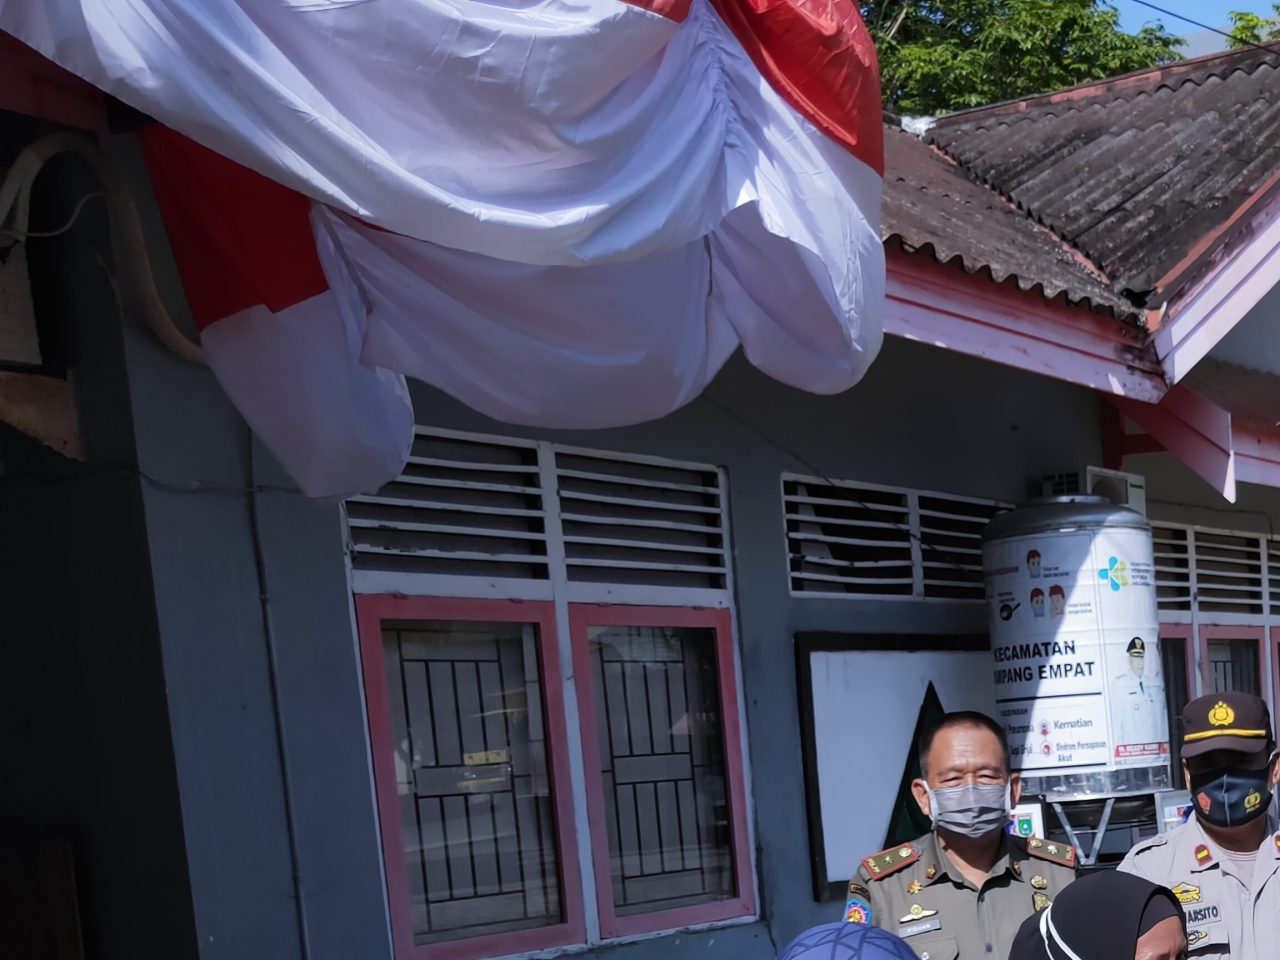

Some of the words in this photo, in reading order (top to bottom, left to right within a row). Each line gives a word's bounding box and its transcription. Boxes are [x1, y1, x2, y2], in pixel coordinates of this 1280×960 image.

[1038, 661, 1095, 679] EMPAT
[1053, 718, 1093, 729] Kematian
[1184, 905, 1220, 924] ARSITO
